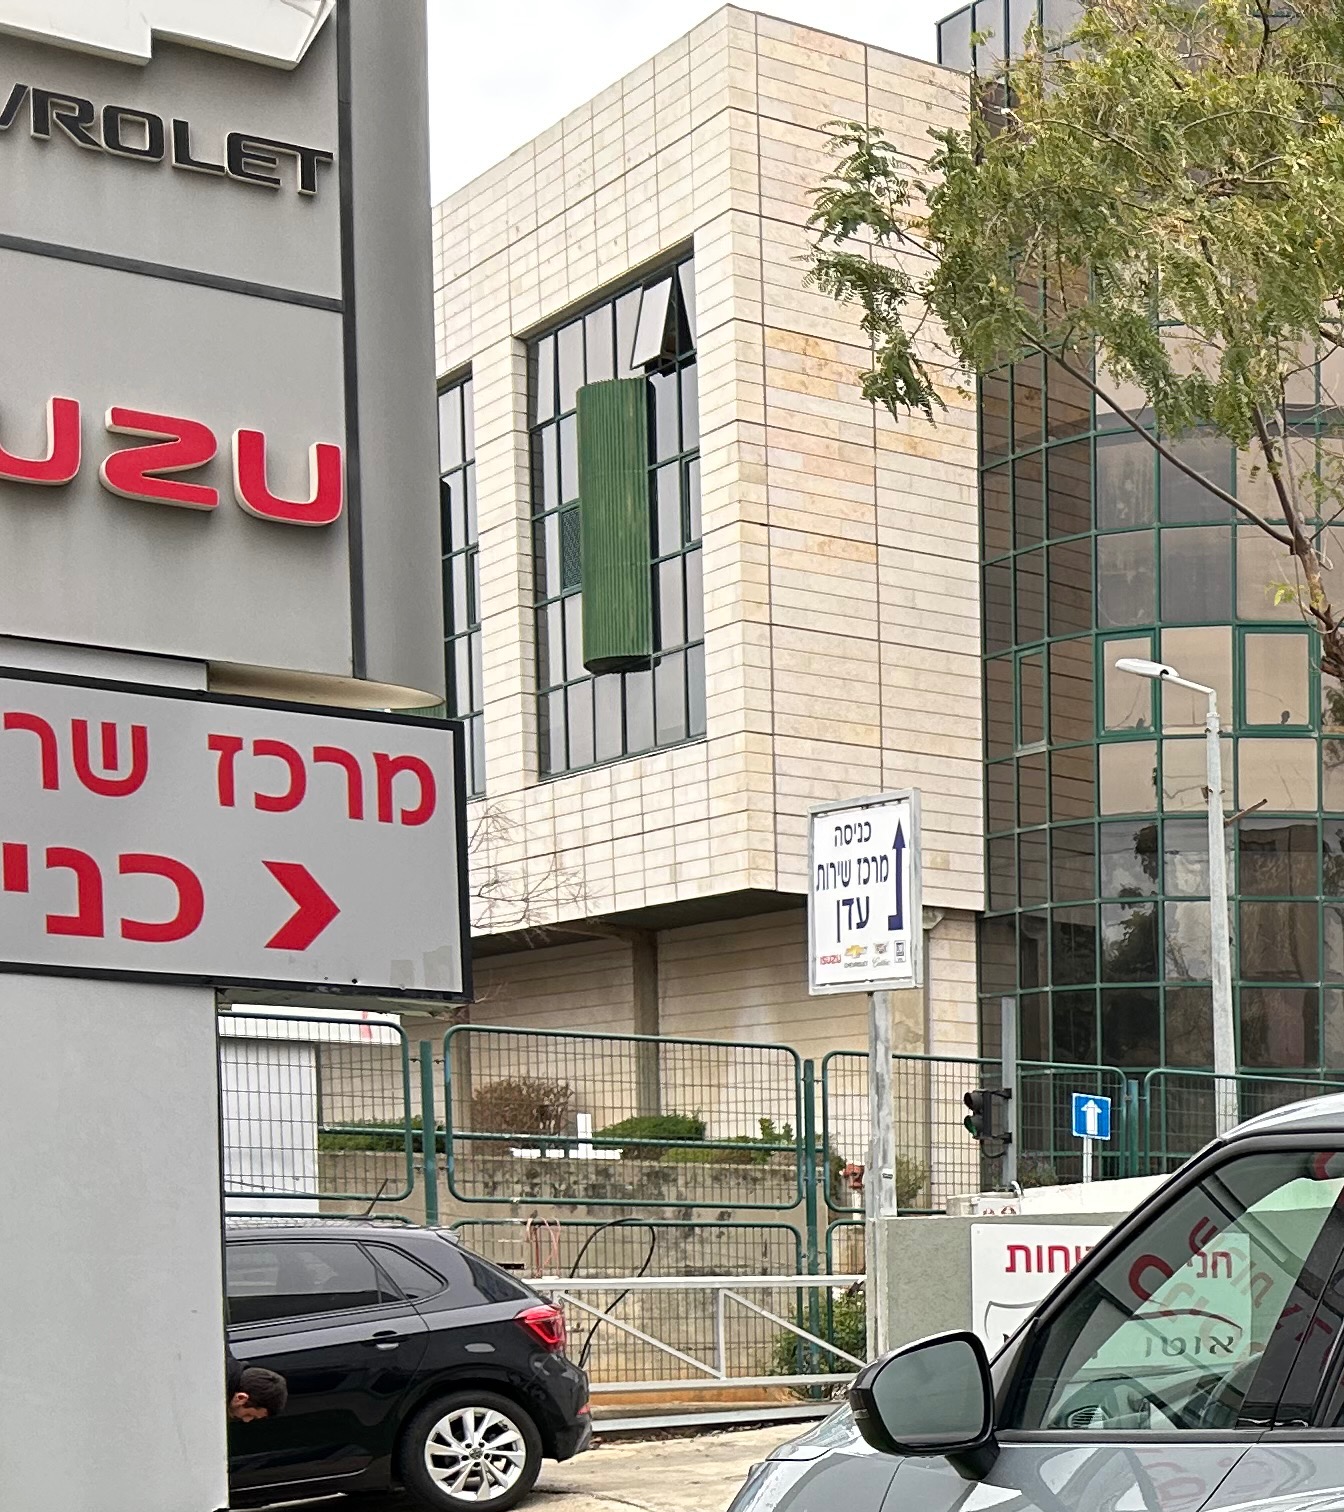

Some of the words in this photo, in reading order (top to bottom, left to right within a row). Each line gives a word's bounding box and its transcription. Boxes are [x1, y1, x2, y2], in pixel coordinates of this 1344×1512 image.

[208, 733, 437, 826] מרכז
[834, 821, 872, 847] כניסה
[816, 859, 851, 891] שירות
[857, 854, 889, 886] מרכז
[836, 896, 870, 943] עדן
[1145, 1336, 1233, 1358] אוטו
